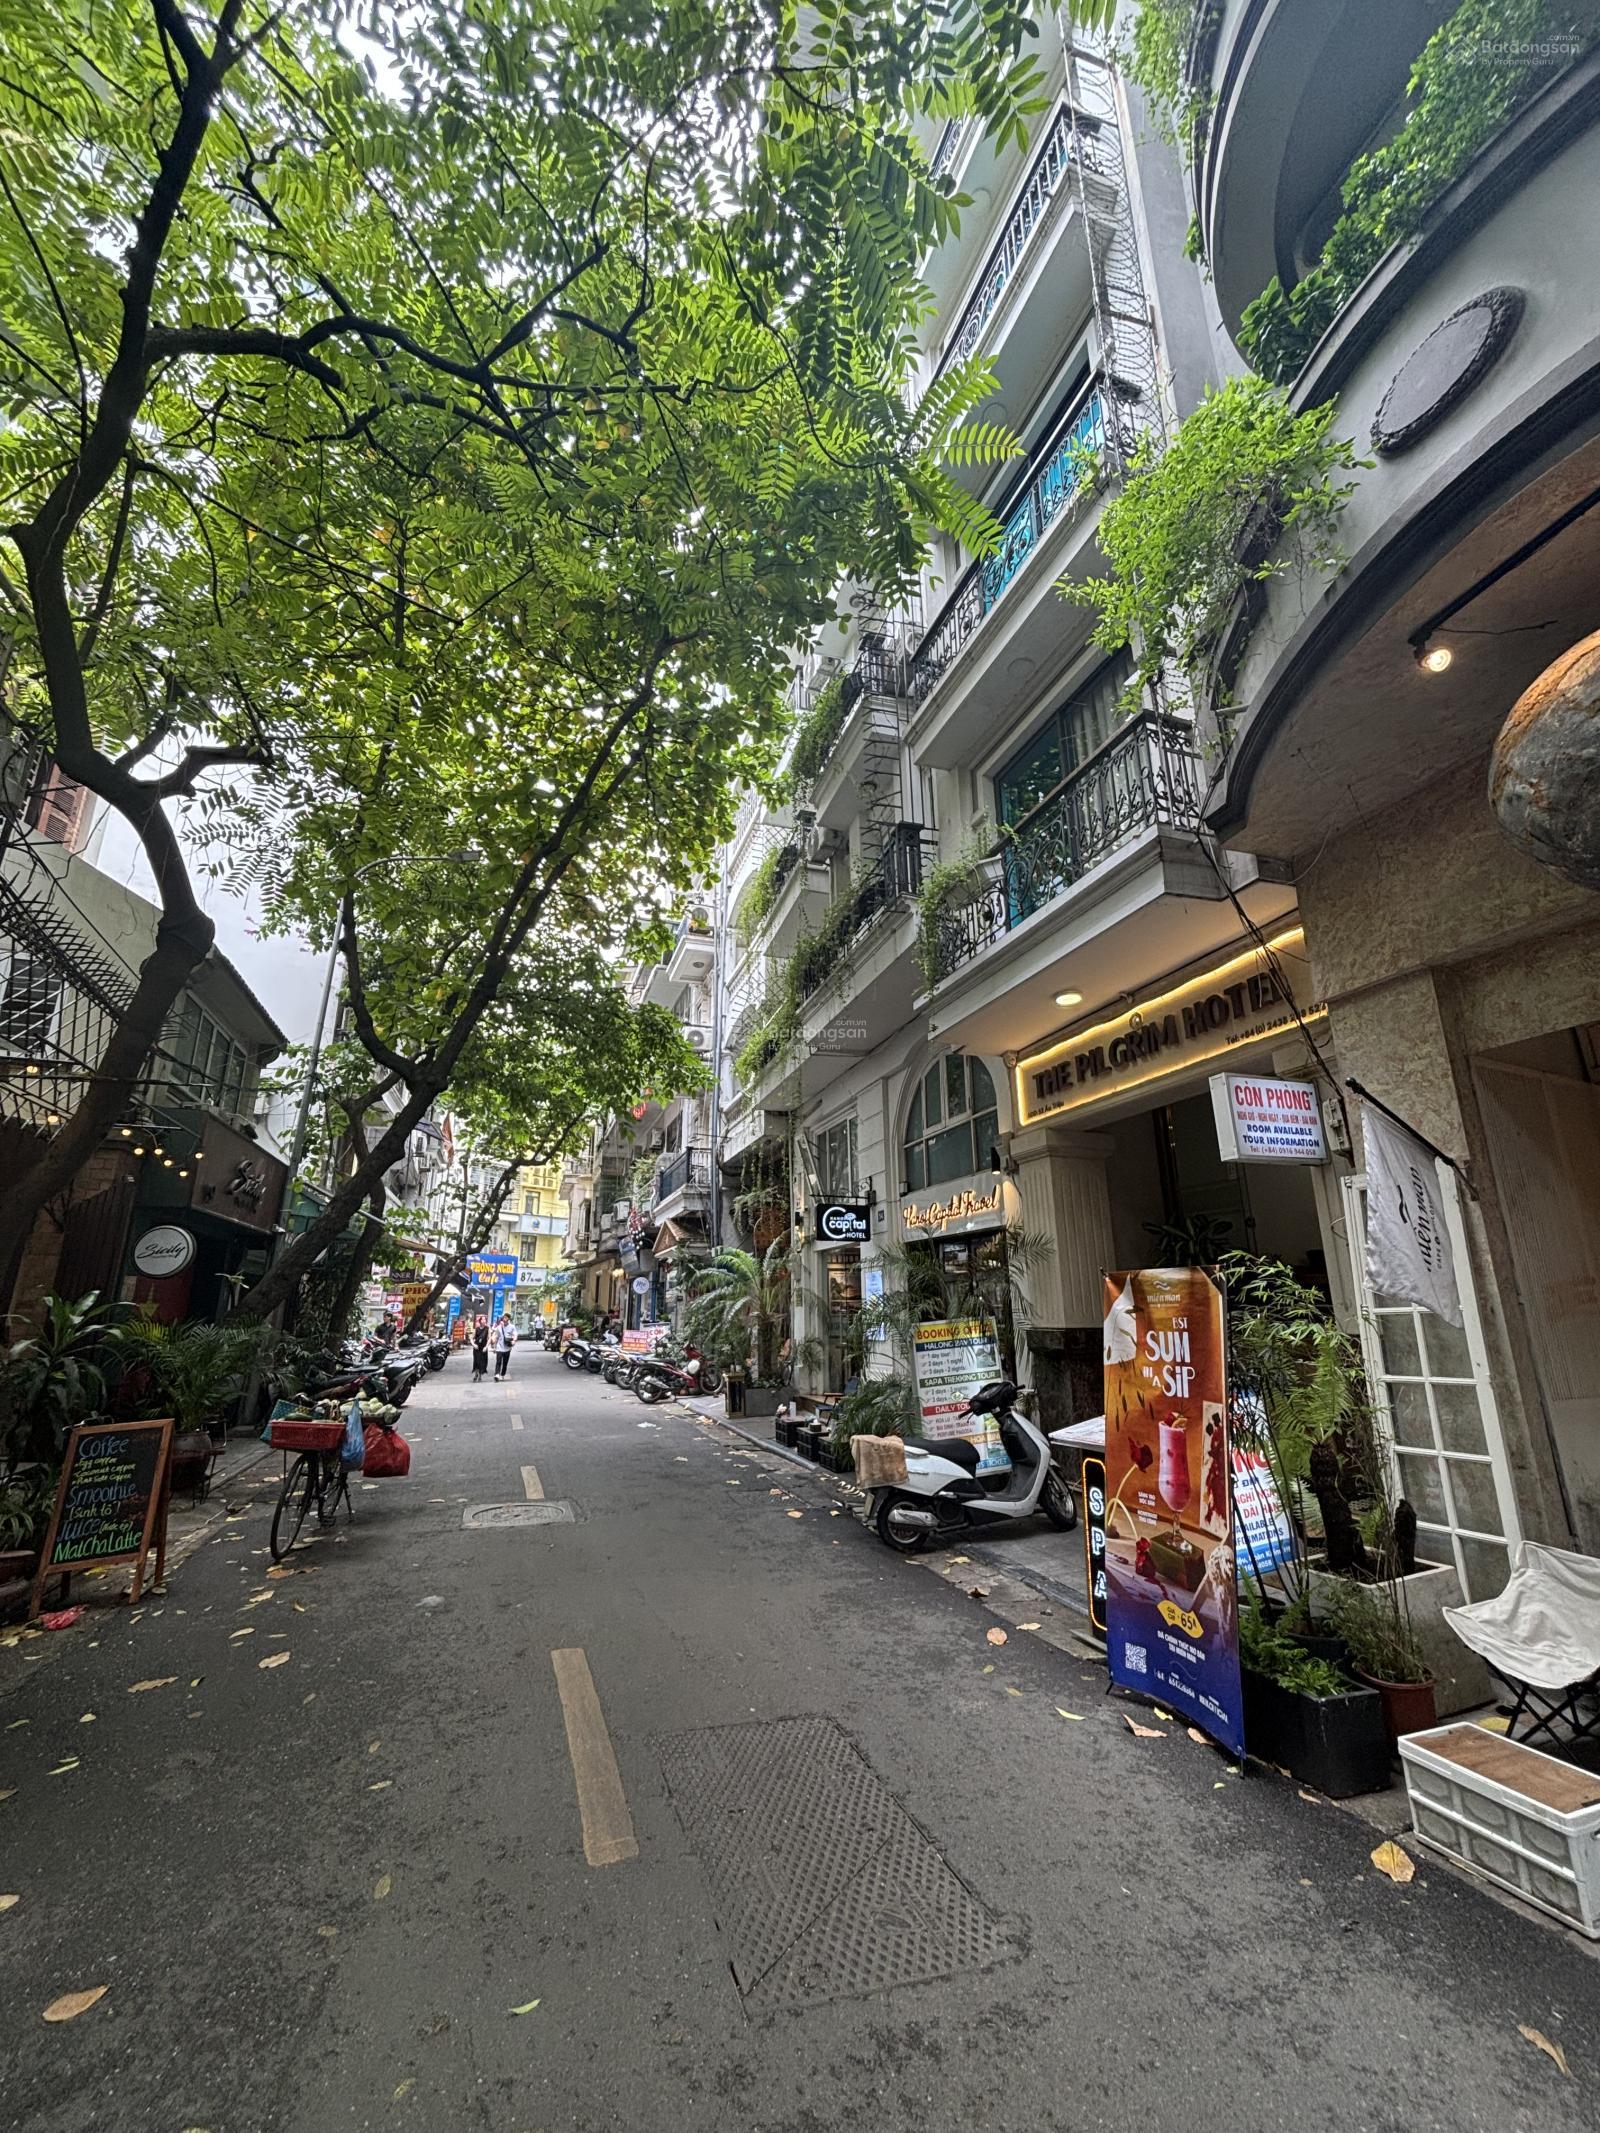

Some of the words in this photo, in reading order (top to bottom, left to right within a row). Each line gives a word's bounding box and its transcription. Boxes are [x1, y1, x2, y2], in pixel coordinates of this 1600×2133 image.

[1032, 1060, 1074, 1099] THE
[1075, 1014, 1180, 1083] PILGRIM
[1234, 1080, 1264, 1107] CÒN
[1265, 1084, 1312, 1111] PHÒNG
[1247, 1124, 1271, 1133] ROOM
[1273, 1126, 1313, 1136] AVAILABLE
[1243, 1135, 1265, 1144] TOUR
[1267, 1136, 1320, 1147] INFORMATION
[137, 1242, 186, 1259] Sicily
[520, 1272, 531, 1283] 87
[1172, 1317, 1188, 1329] EST
[917, 1327, 960, 1340] BOOKING
[924, 1341, 953, 1351] HALONG
[970, 1337, 988, 1345] TOUR
[1145, 1330, 1191, 1363] SUM
[925, 1377, 943, 1386] SAPA
[945, 1373, 976, 1384] TREKKING
[978, 1371, 996, 1379] TOUR
[1151, 1377, 1162, 1388] A
[935, 1405, 955, 1413] DAILY
[79, 1435, 129, 1458] Coffee
[66, 1482, 136, 1508] Smoothie
